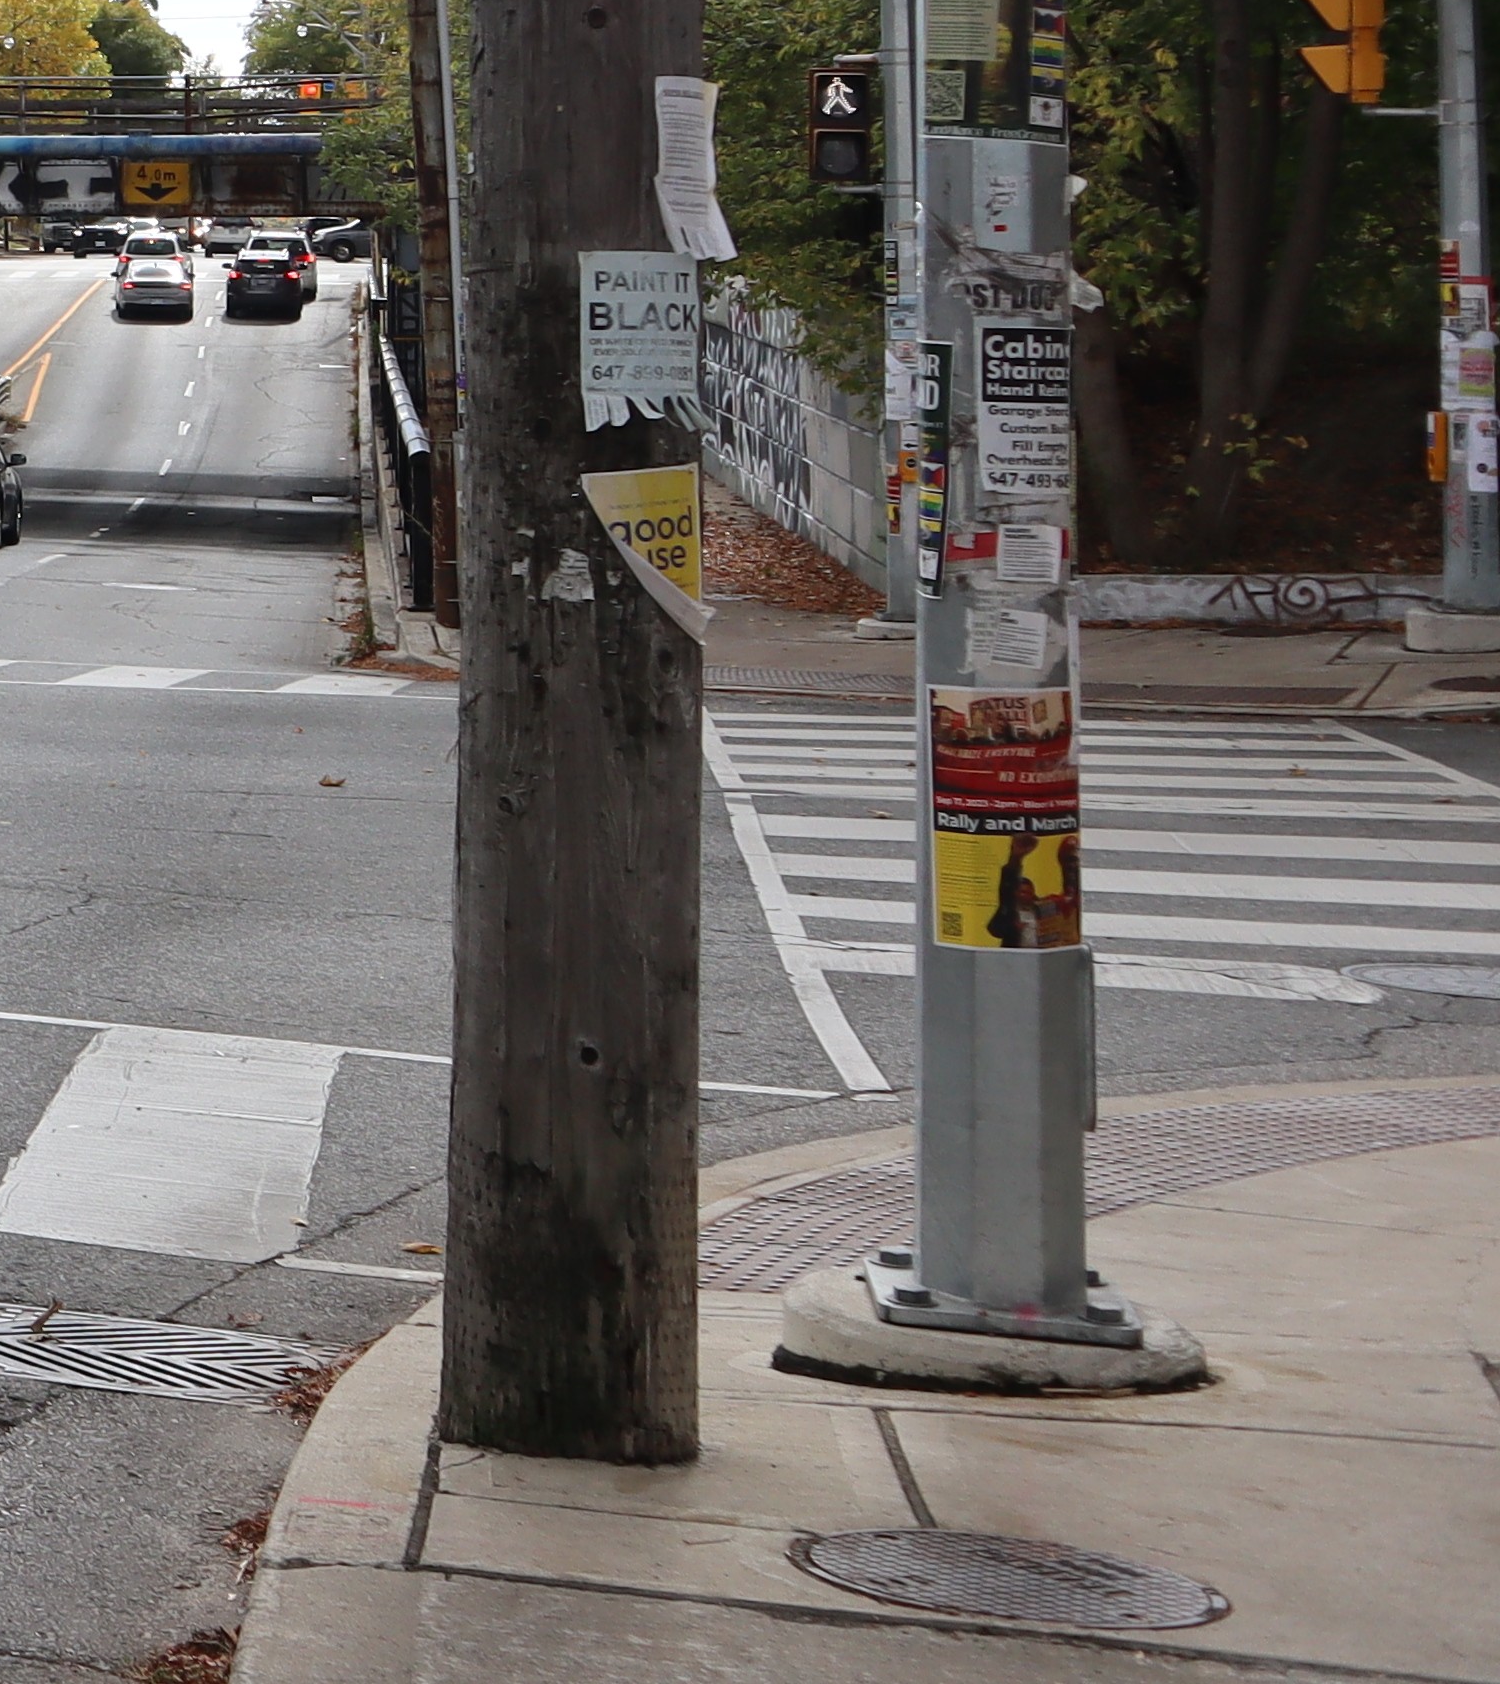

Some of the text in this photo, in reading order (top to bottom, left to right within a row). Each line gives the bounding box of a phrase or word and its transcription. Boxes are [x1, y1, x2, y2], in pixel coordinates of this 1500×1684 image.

[136, 164, 179, 183] 4.0m
[594, 270, 690, 293] PAINT IT
[588, 301, 698, 333] BLACK
[986, 382, 1034, 396] Hand
[988, 404, 1043, 419] Garage
[999, 422, 1048, 434] Custom
[1012, 440, 1033, 452] Fill
[608, 505, 693, 547] good
[998, 771, 1016, 783] NO
[937, 811, 1078, 833] Rally and March
